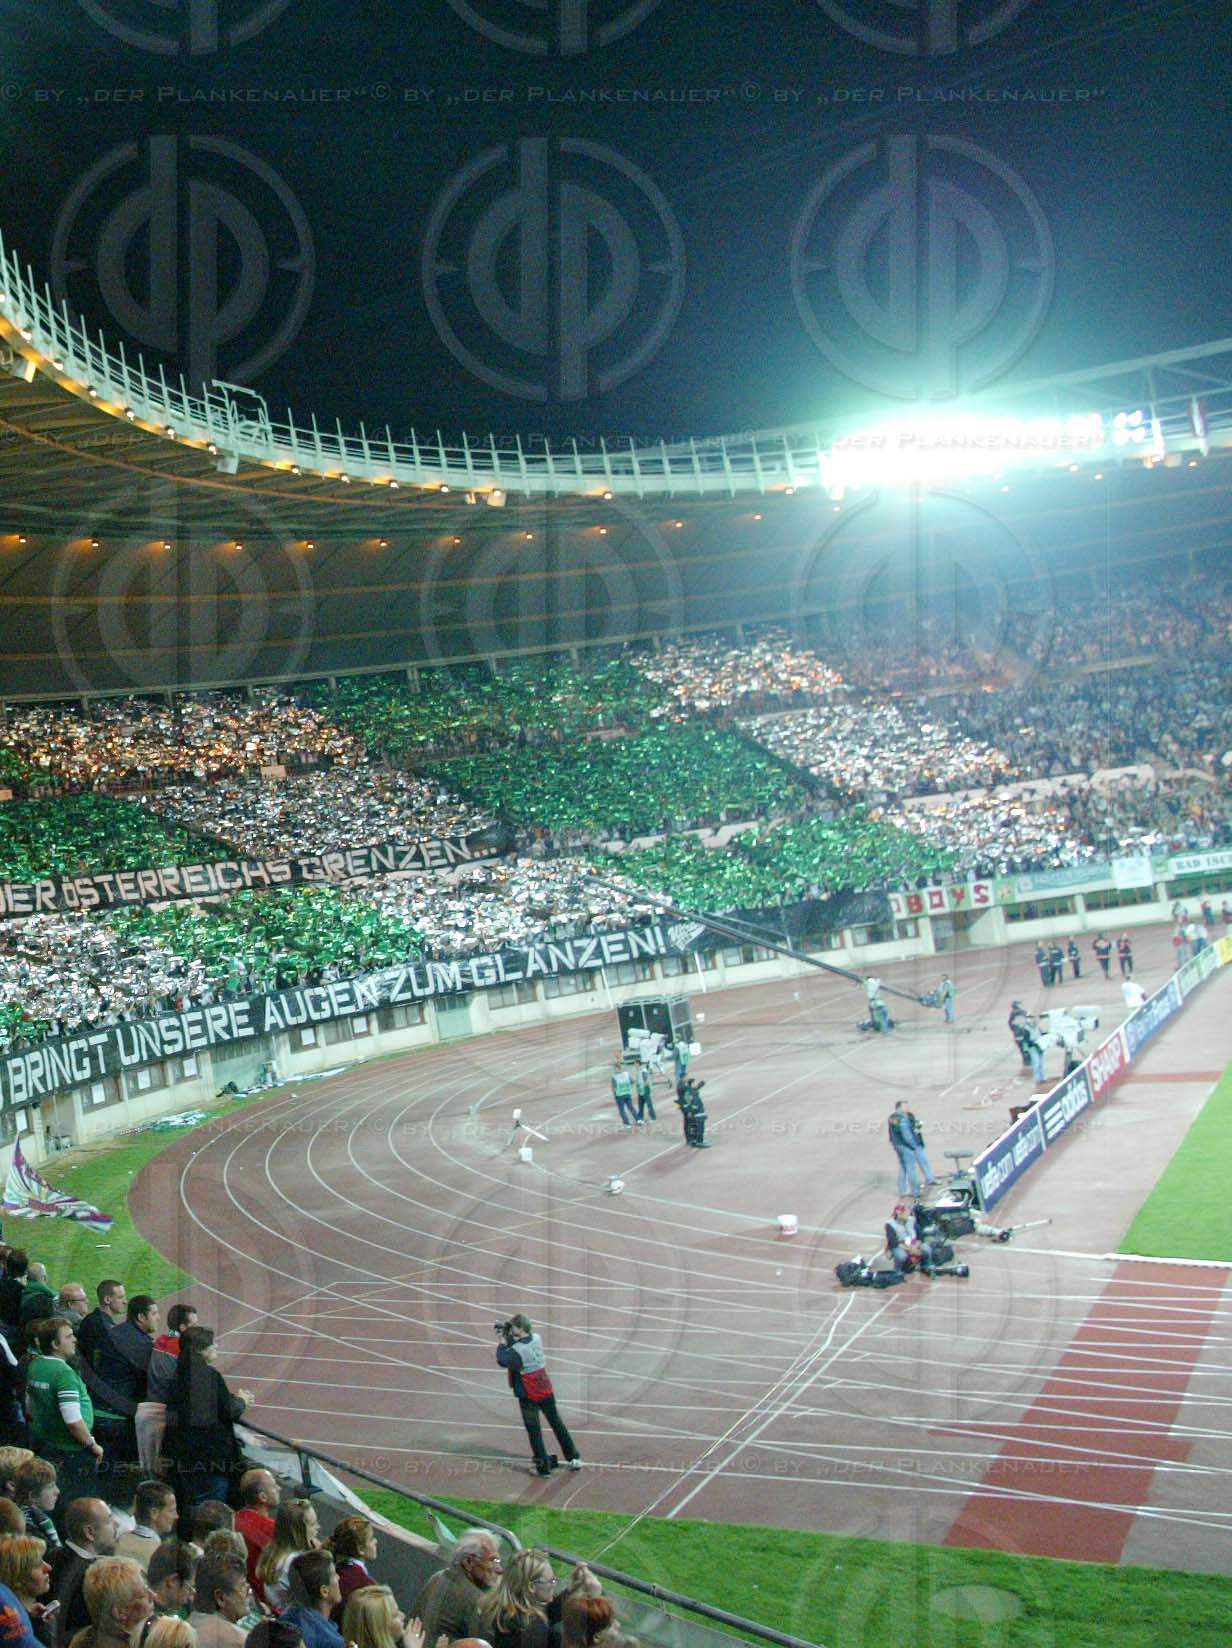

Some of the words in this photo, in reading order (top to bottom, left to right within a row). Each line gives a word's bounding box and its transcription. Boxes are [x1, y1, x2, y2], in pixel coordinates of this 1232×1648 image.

[61, 861, 292, 907] ÖSTERREICHS
[906, 884, 990, 912] BOYS
[6, 1033, 109, 1104] BRINGT
[115, 1002, 255, 1066] UNSERE
[264, 977, 379, 1032] AUGEN
[383, 961, 463, 1002] ZUM
